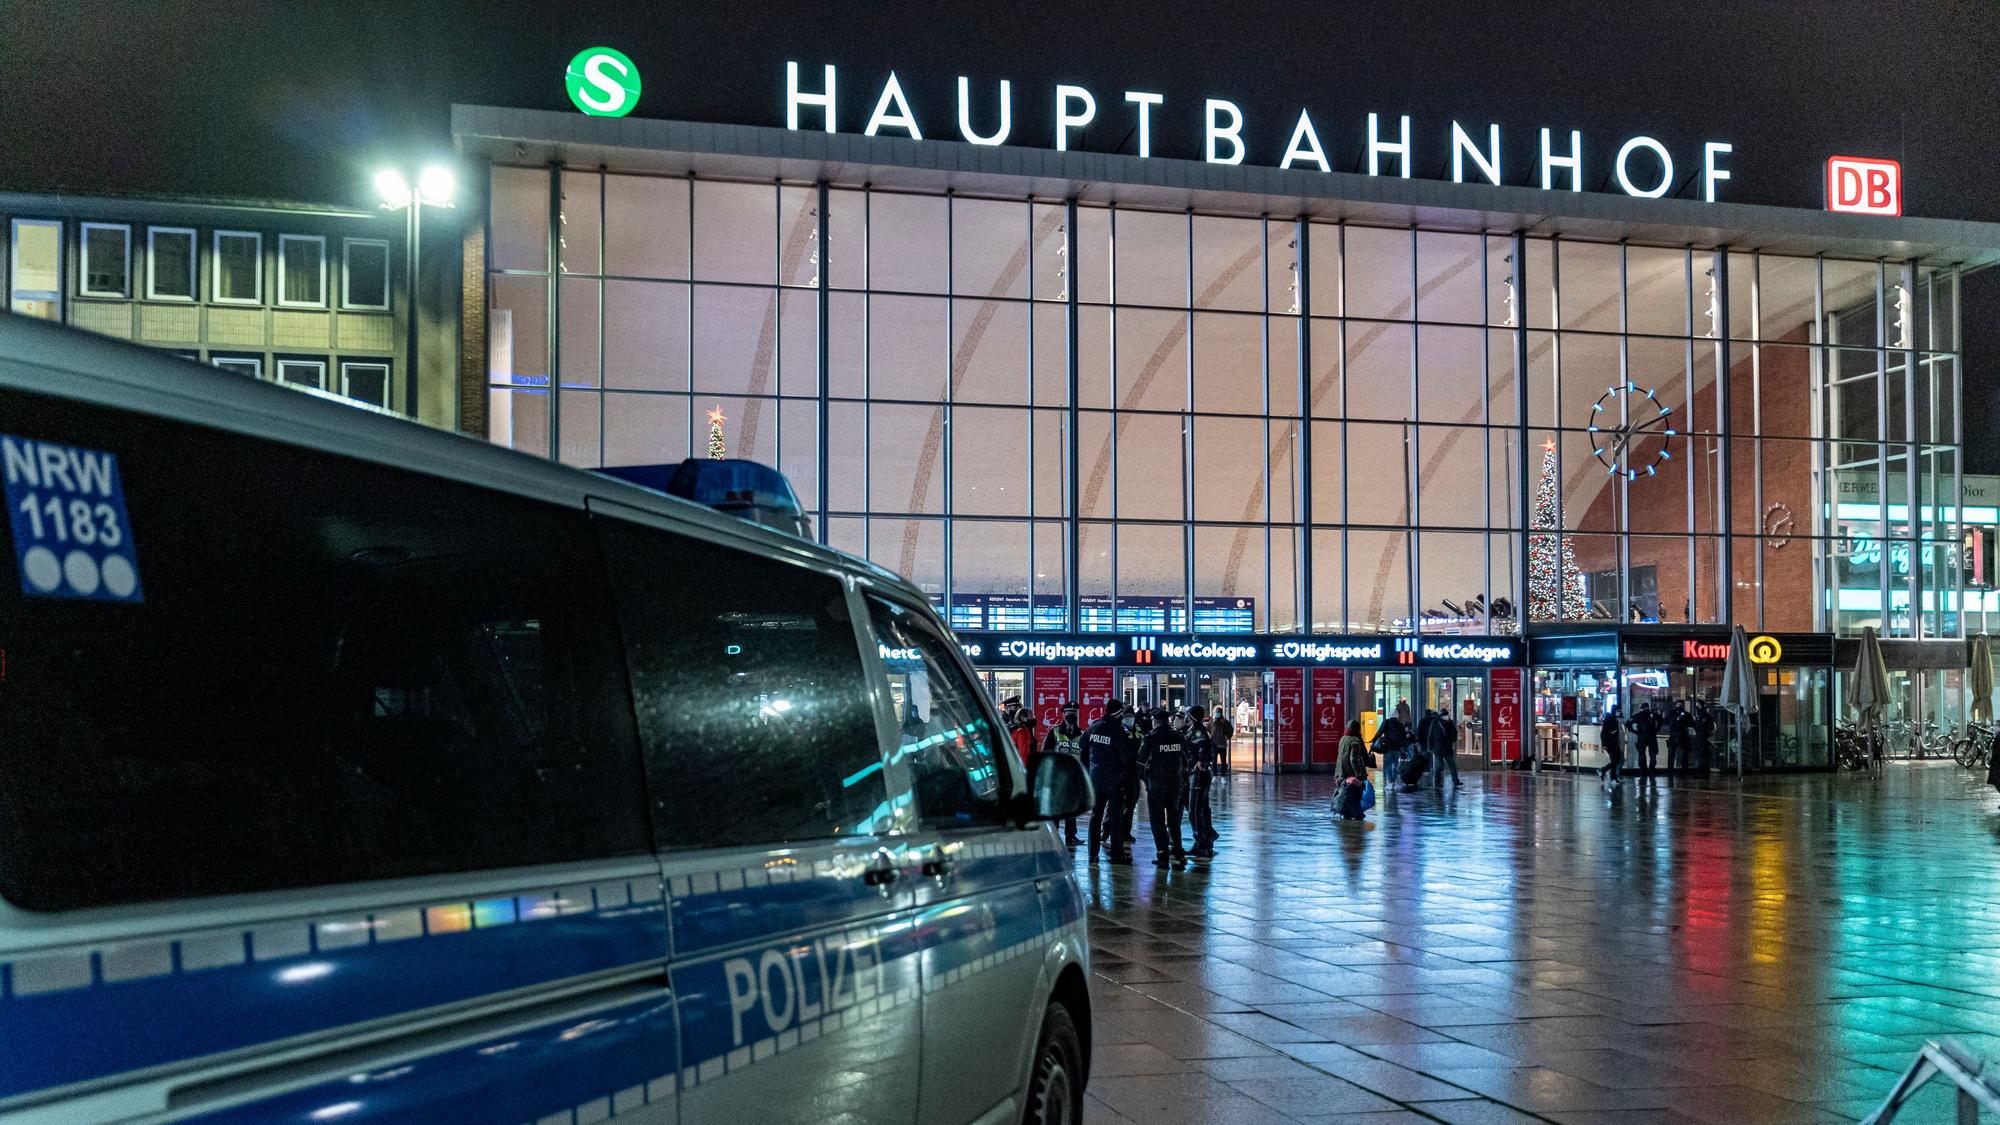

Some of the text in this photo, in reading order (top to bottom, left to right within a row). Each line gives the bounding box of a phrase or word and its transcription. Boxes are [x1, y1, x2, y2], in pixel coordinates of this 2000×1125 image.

[577, 52, 629, 113] S
[786, 60, 1733, 203] HAUPTBAHNHOF
[1837, 166, 1892, 210] DB
[2, 435, 112, 497] NRW
[1839, 482, 1878, 493] ERME
[20, 491, 122, 547] 1183
[1029, 642, 1116, 661] Highspeed
[1162, 642, 1256, 661] NetCologne
[1301, 643, 1381, 661] Highspeed
[1423, 644, 1511, 662] NetCologne
[1683, 640, 1731, 660] Kam
[1058, 741, 1080, 749] POLIZ
[1089, 733, 1111, 745] POLIZEI
[1159, 743, 1181, 753] POLIZEI
[724, 930, 884, 1046] POLIZEI
